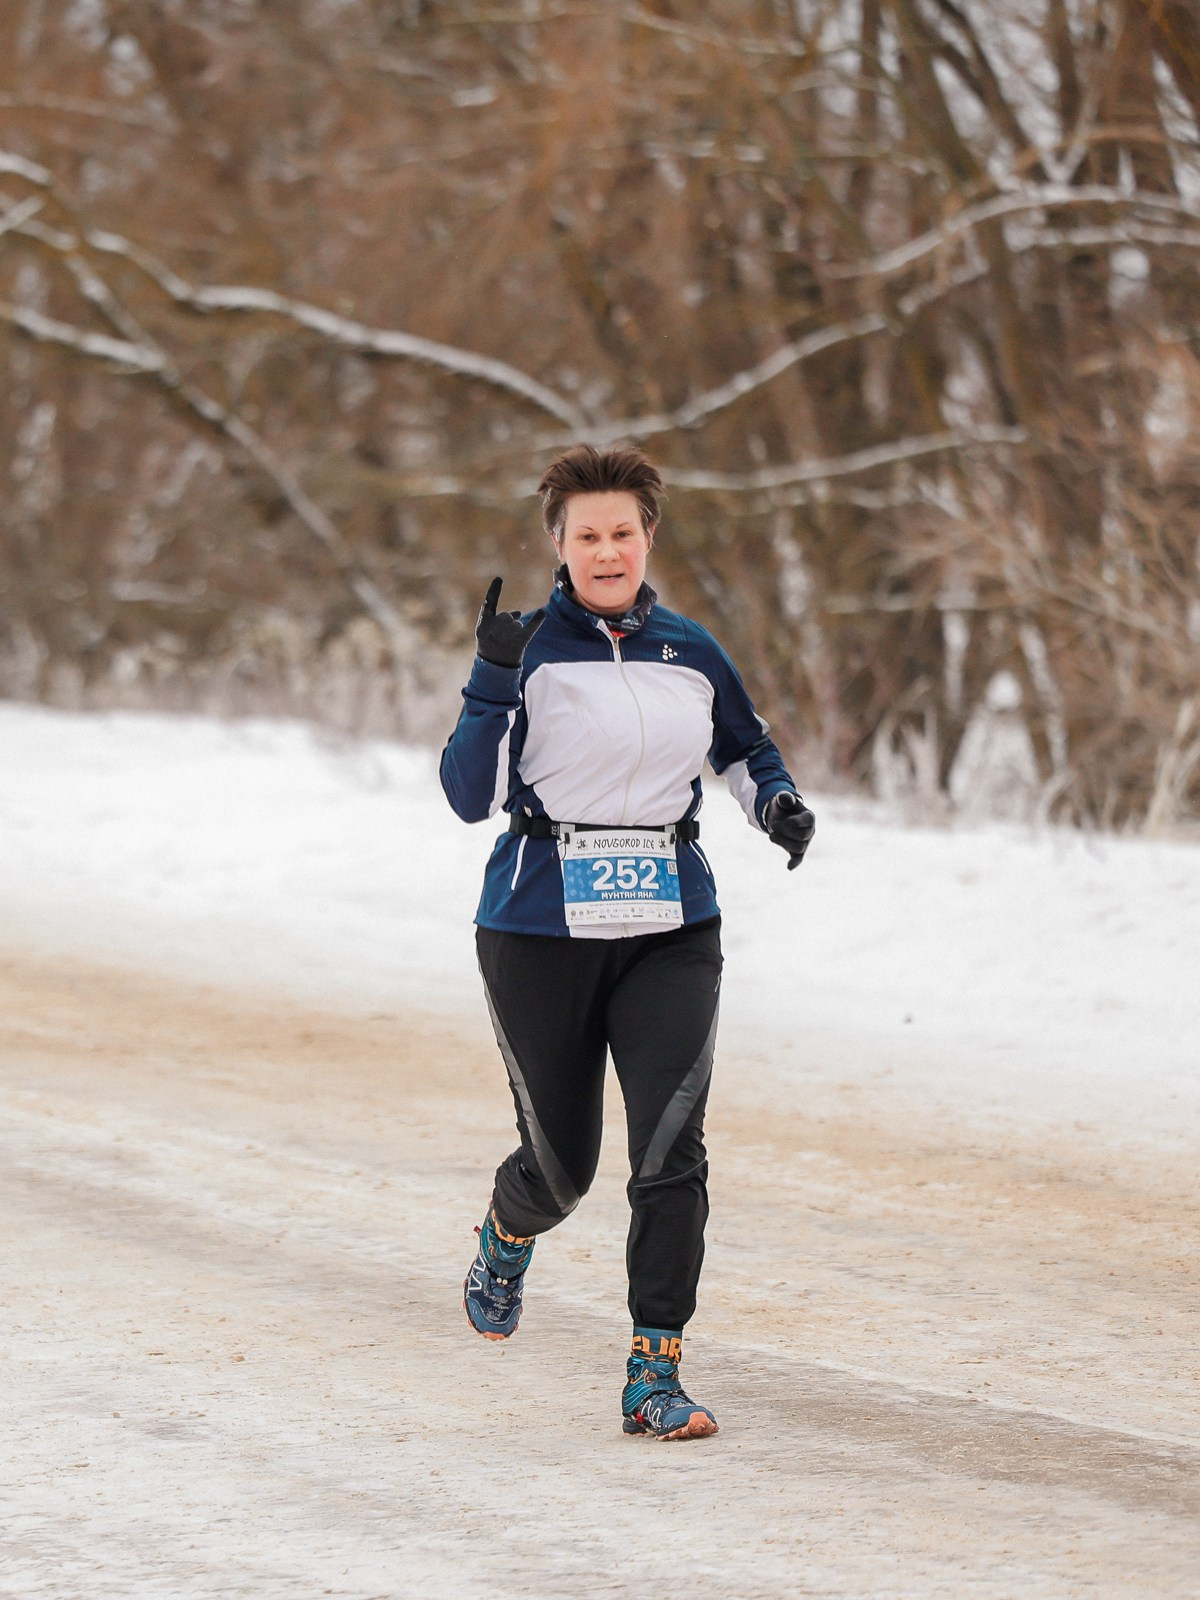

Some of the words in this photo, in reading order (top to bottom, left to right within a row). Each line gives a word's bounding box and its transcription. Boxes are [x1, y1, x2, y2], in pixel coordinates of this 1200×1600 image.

[593, 837, 641, 849] NOVGOROD
[592, 859, 660, 891] 252
[601, 891, 636, 899] МУНТЯН
[638, 891, 654, 899] ЯНА
